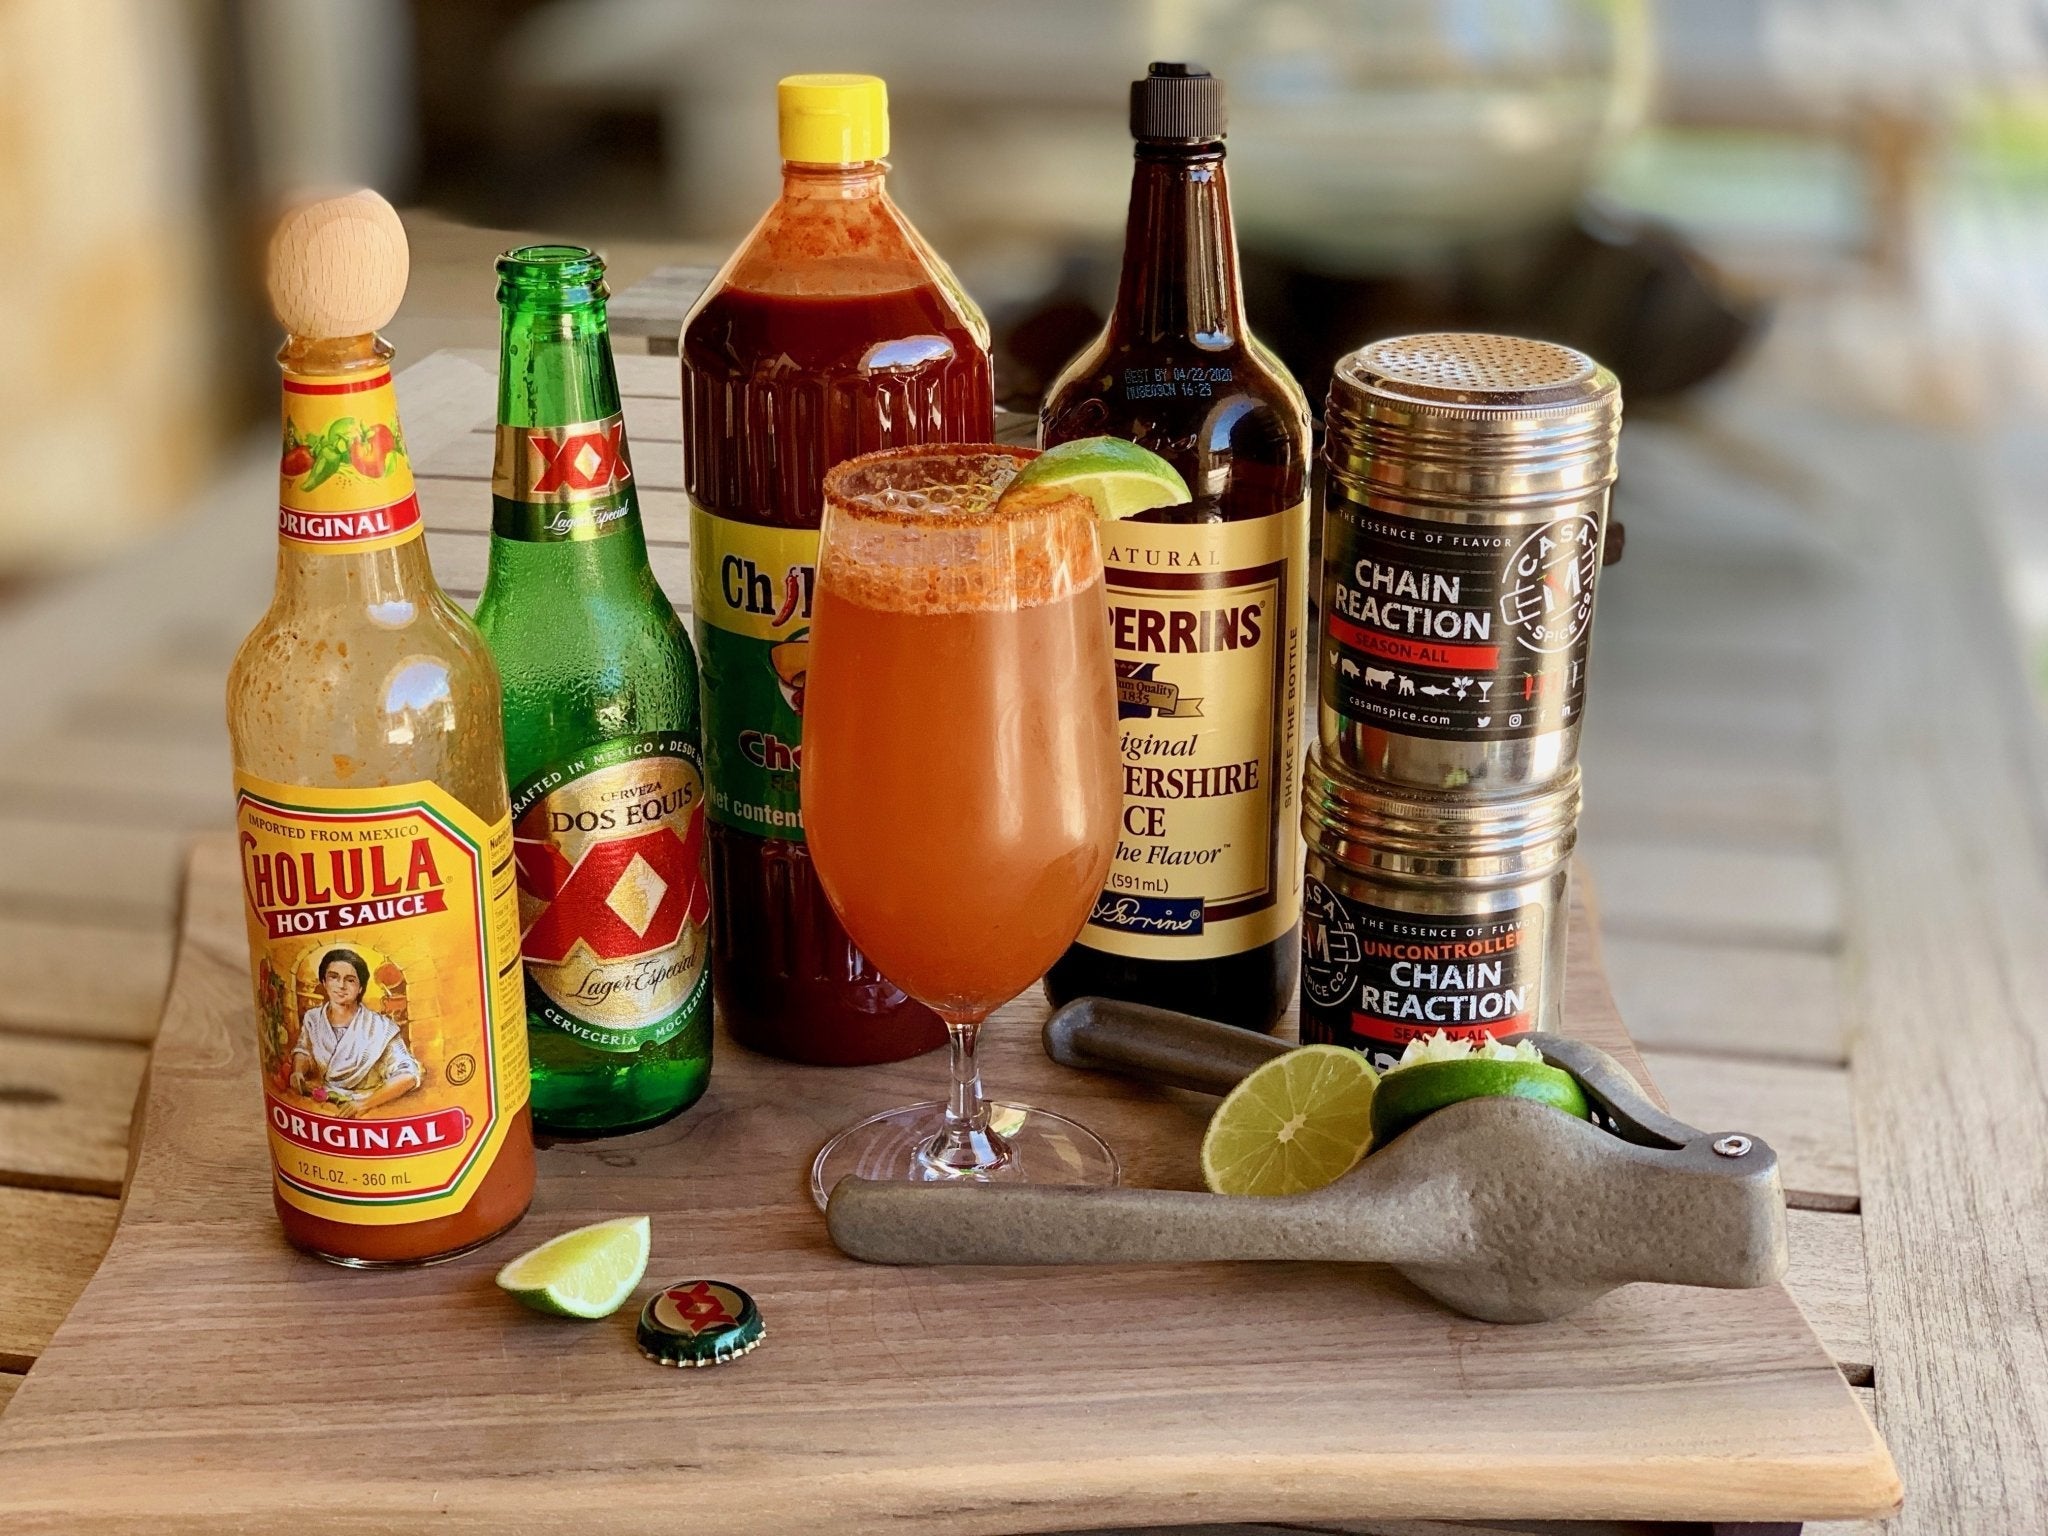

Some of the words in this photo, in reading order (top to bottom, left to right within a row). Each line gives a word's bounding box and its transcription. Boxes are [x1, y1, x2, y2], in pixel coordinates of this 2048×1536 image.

[1155, 368, 1167, 382] BY
[1174, 367, 1233, 382] 04/22/2020
[279, 509, 390, 538] ORIGINAL
[1339, 510, 1356, 524] THE
[1360, 519, 1416, 541] ESSENCE
[1425, 534, 1443, 544] OF
[1453, 537, 1512, 548] FLAVOR
[1107, 546, 1220, 567] ATURAL
[1517, 523, 1589, 577] CASA
[1355, 559, 1461, 604] CHAIN
[1335, 582, 1492, 640] REACTION
[1108, 603, 1263, 654] ERRINS
[1531, 620, 1578, 643] SPICE
[1288, 626, 1298, 701] BOTTLE
[1355, 632, 1450, 664] SEASON-ALL
[1122, 690, 1151, 705] 1835
[1136, 681, 1174, 699] Quality
[1286, 705, 1296, 743] THE
[1349, 696, 1451, 726] casamspice.com
[568, 760, 585, 775] IN
[593, 741, 654, 766] MEXICO
[670, 740, 696, 759] DESDE
[1120, 731, 1199, 761] iginal
[600, 781, 663, 803] CERVEZA
[1122, 759, 1260, 800] ERSHIRE
[1283, 746, 1295, 810] SHAKE
[551, 809, 616, 833] DOS
[626, 782, 693, 827] EQUIS
[1123, 805, 1167, 837] CE
[248, 813, 306, 840] IMPORTED
[310, 829, 353, 842] FROM
[359, 824, 419, 842] MEXICO
[1115, 841, 1142, 863] he
[1145, 844, 1223, 867] Flavor
[240, 830, 445, 927] CHOLULA
[276, 909, 331, 934] HOT
[338, 895, 428, 927] SAUCE
[1306, 882, 1335, 922] ASA
[1361, 916, 1385, 930] THE
[1393, 924, 1457, 938] ESSENCE
[1466, 927, 1483, 937] OF
[1363, 930, 1526, 960] UNCONTROLLED
[566, 968, 633, 1007] Lager
[632, 942, 699, 995] Especial
[1390, 961, 1502, 990] CHAIN
[1361, 984, 1526, 1021] REACTION
[272, 1105, 446, 1149] ORIGINAL
[297, 1161, 310, 1176] 12
[362, 1173, 386, 1186] 360
[391, 1172, 412, 1185] mL
